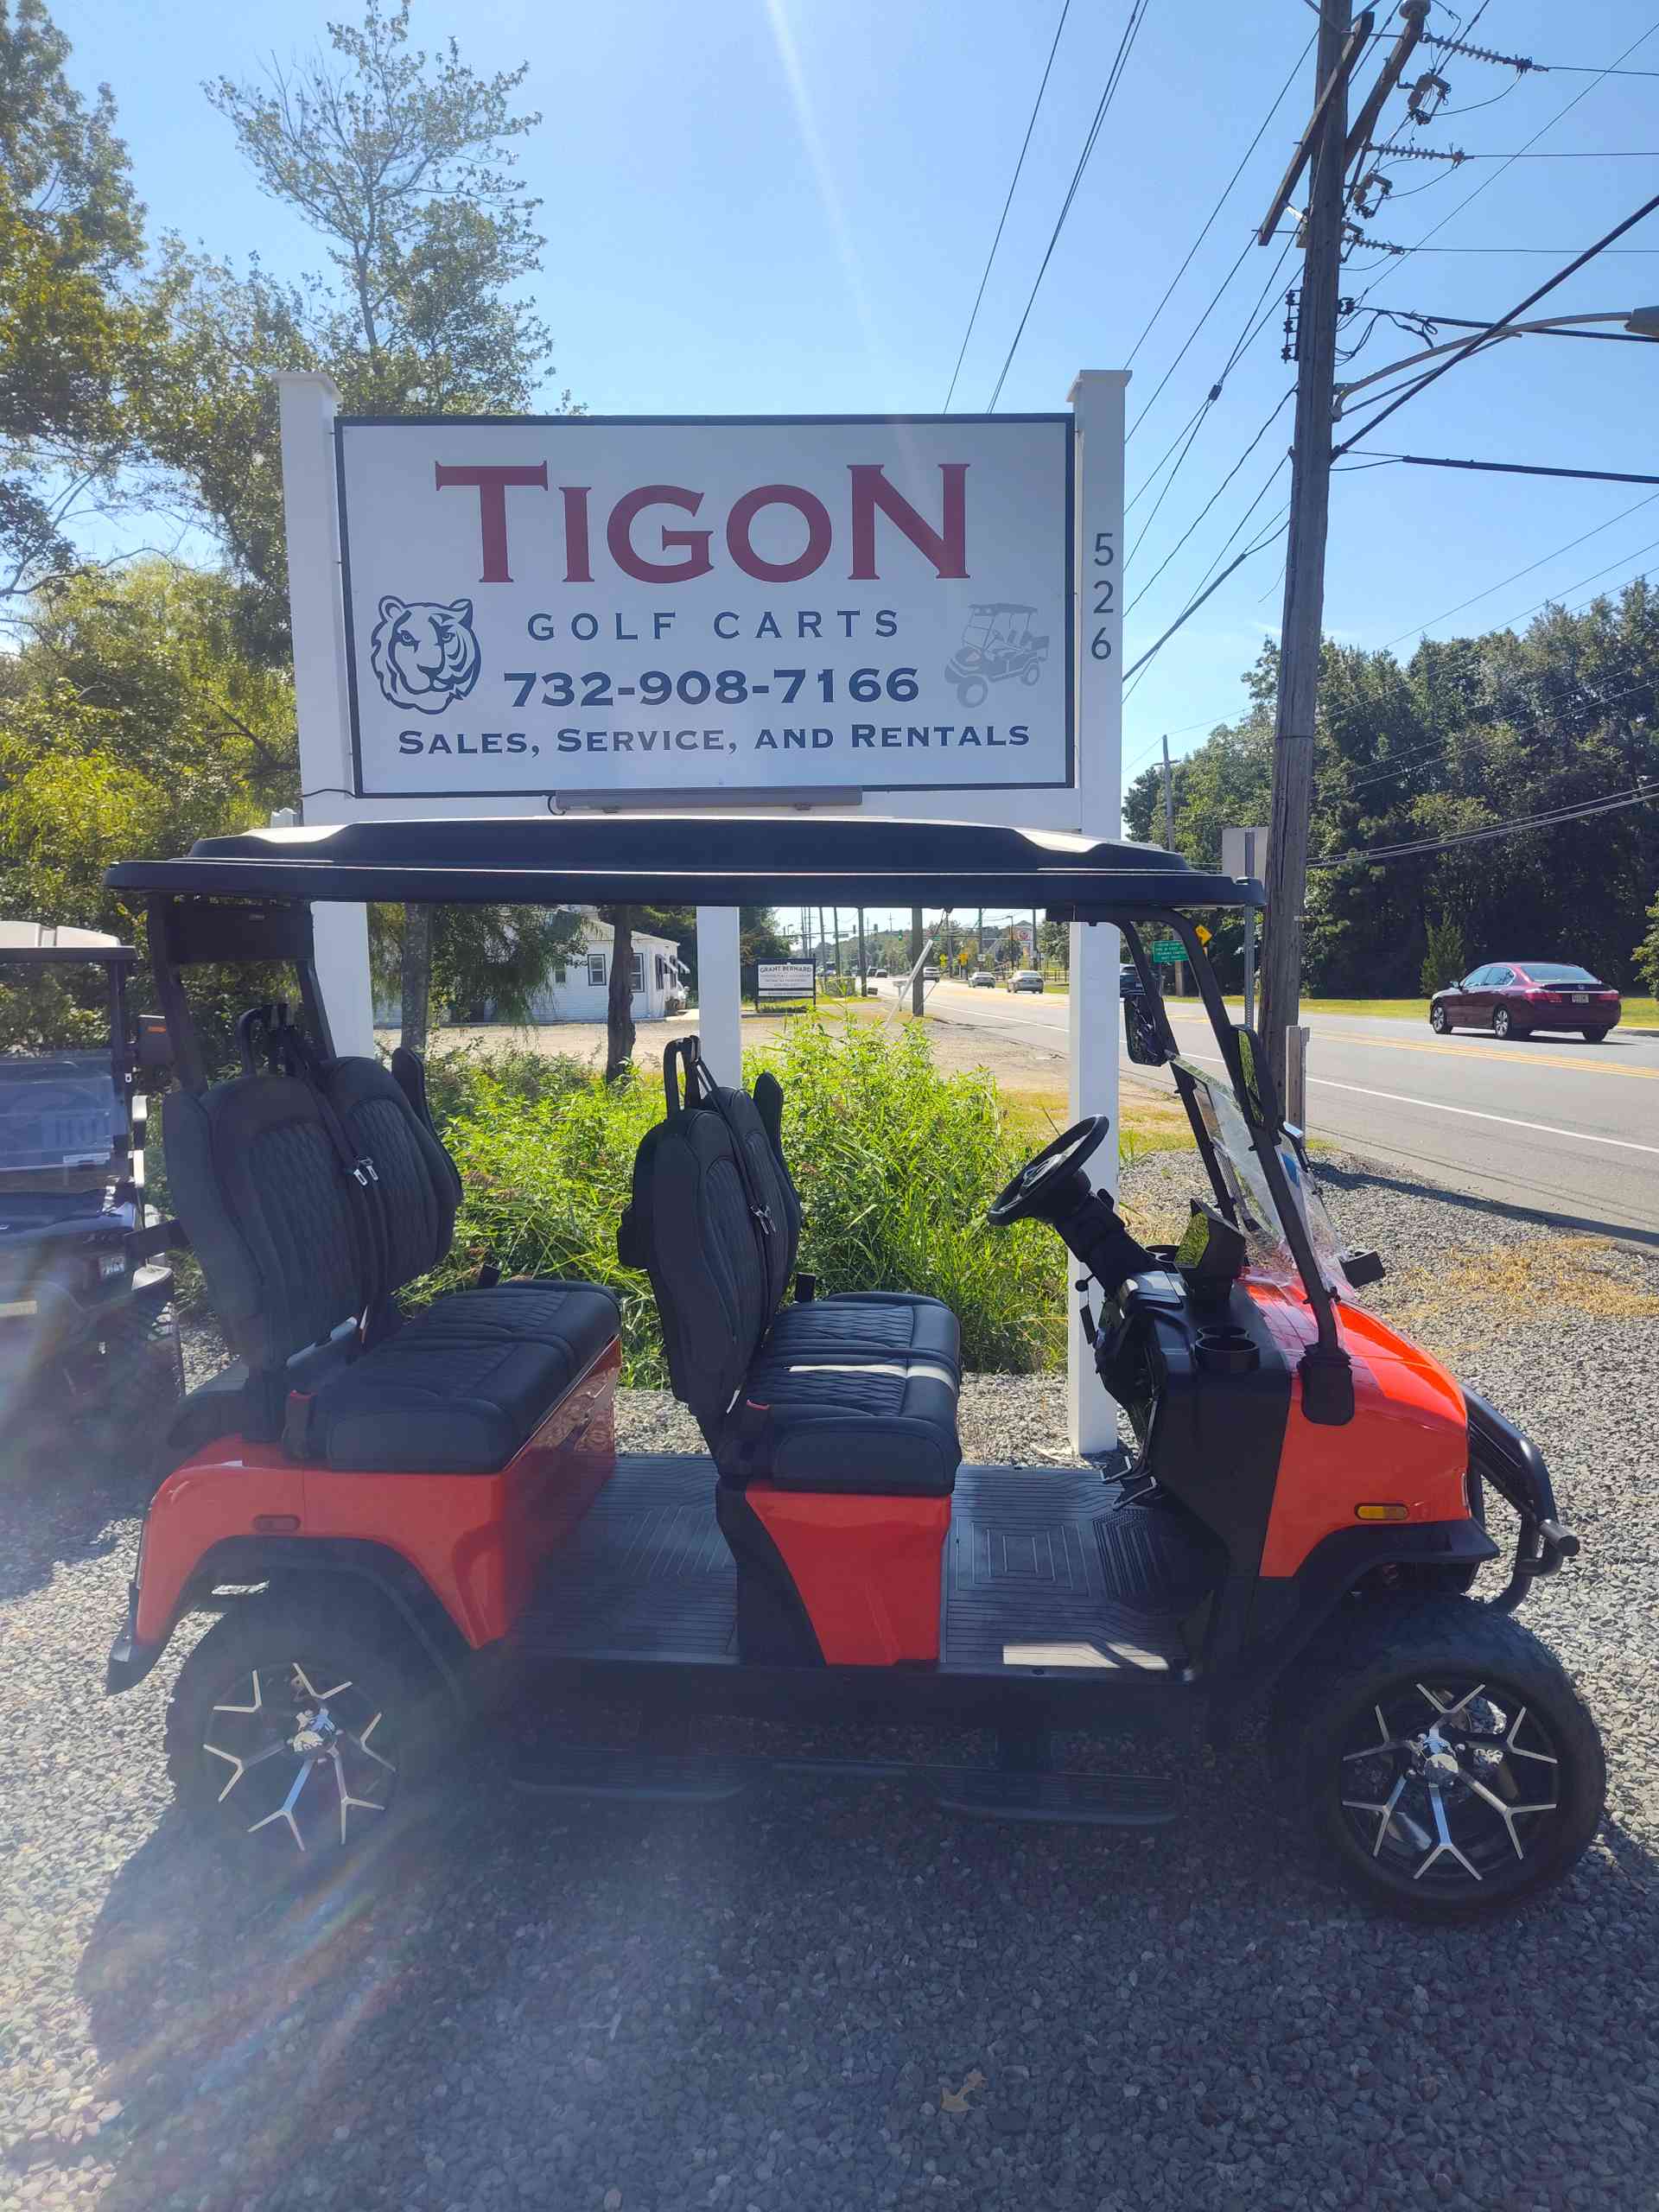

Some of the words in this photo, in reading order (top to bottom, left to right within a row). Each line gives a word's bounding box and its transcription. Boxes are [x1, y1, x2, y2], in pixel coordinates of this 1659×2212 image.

[435, 460, 971, 584] TIGON
[527, 612, 677, 641] GOLF
[713, 607, 898, 639] CARTS
[503, 667, 919, 708] 732-908-7166
[398, 729, 541, 759] SALES,
[556, 728, 738, 755] SERVICE,
[753, 728, 835, 751] AND
[850, 723, 1030, 749] RENTALS
